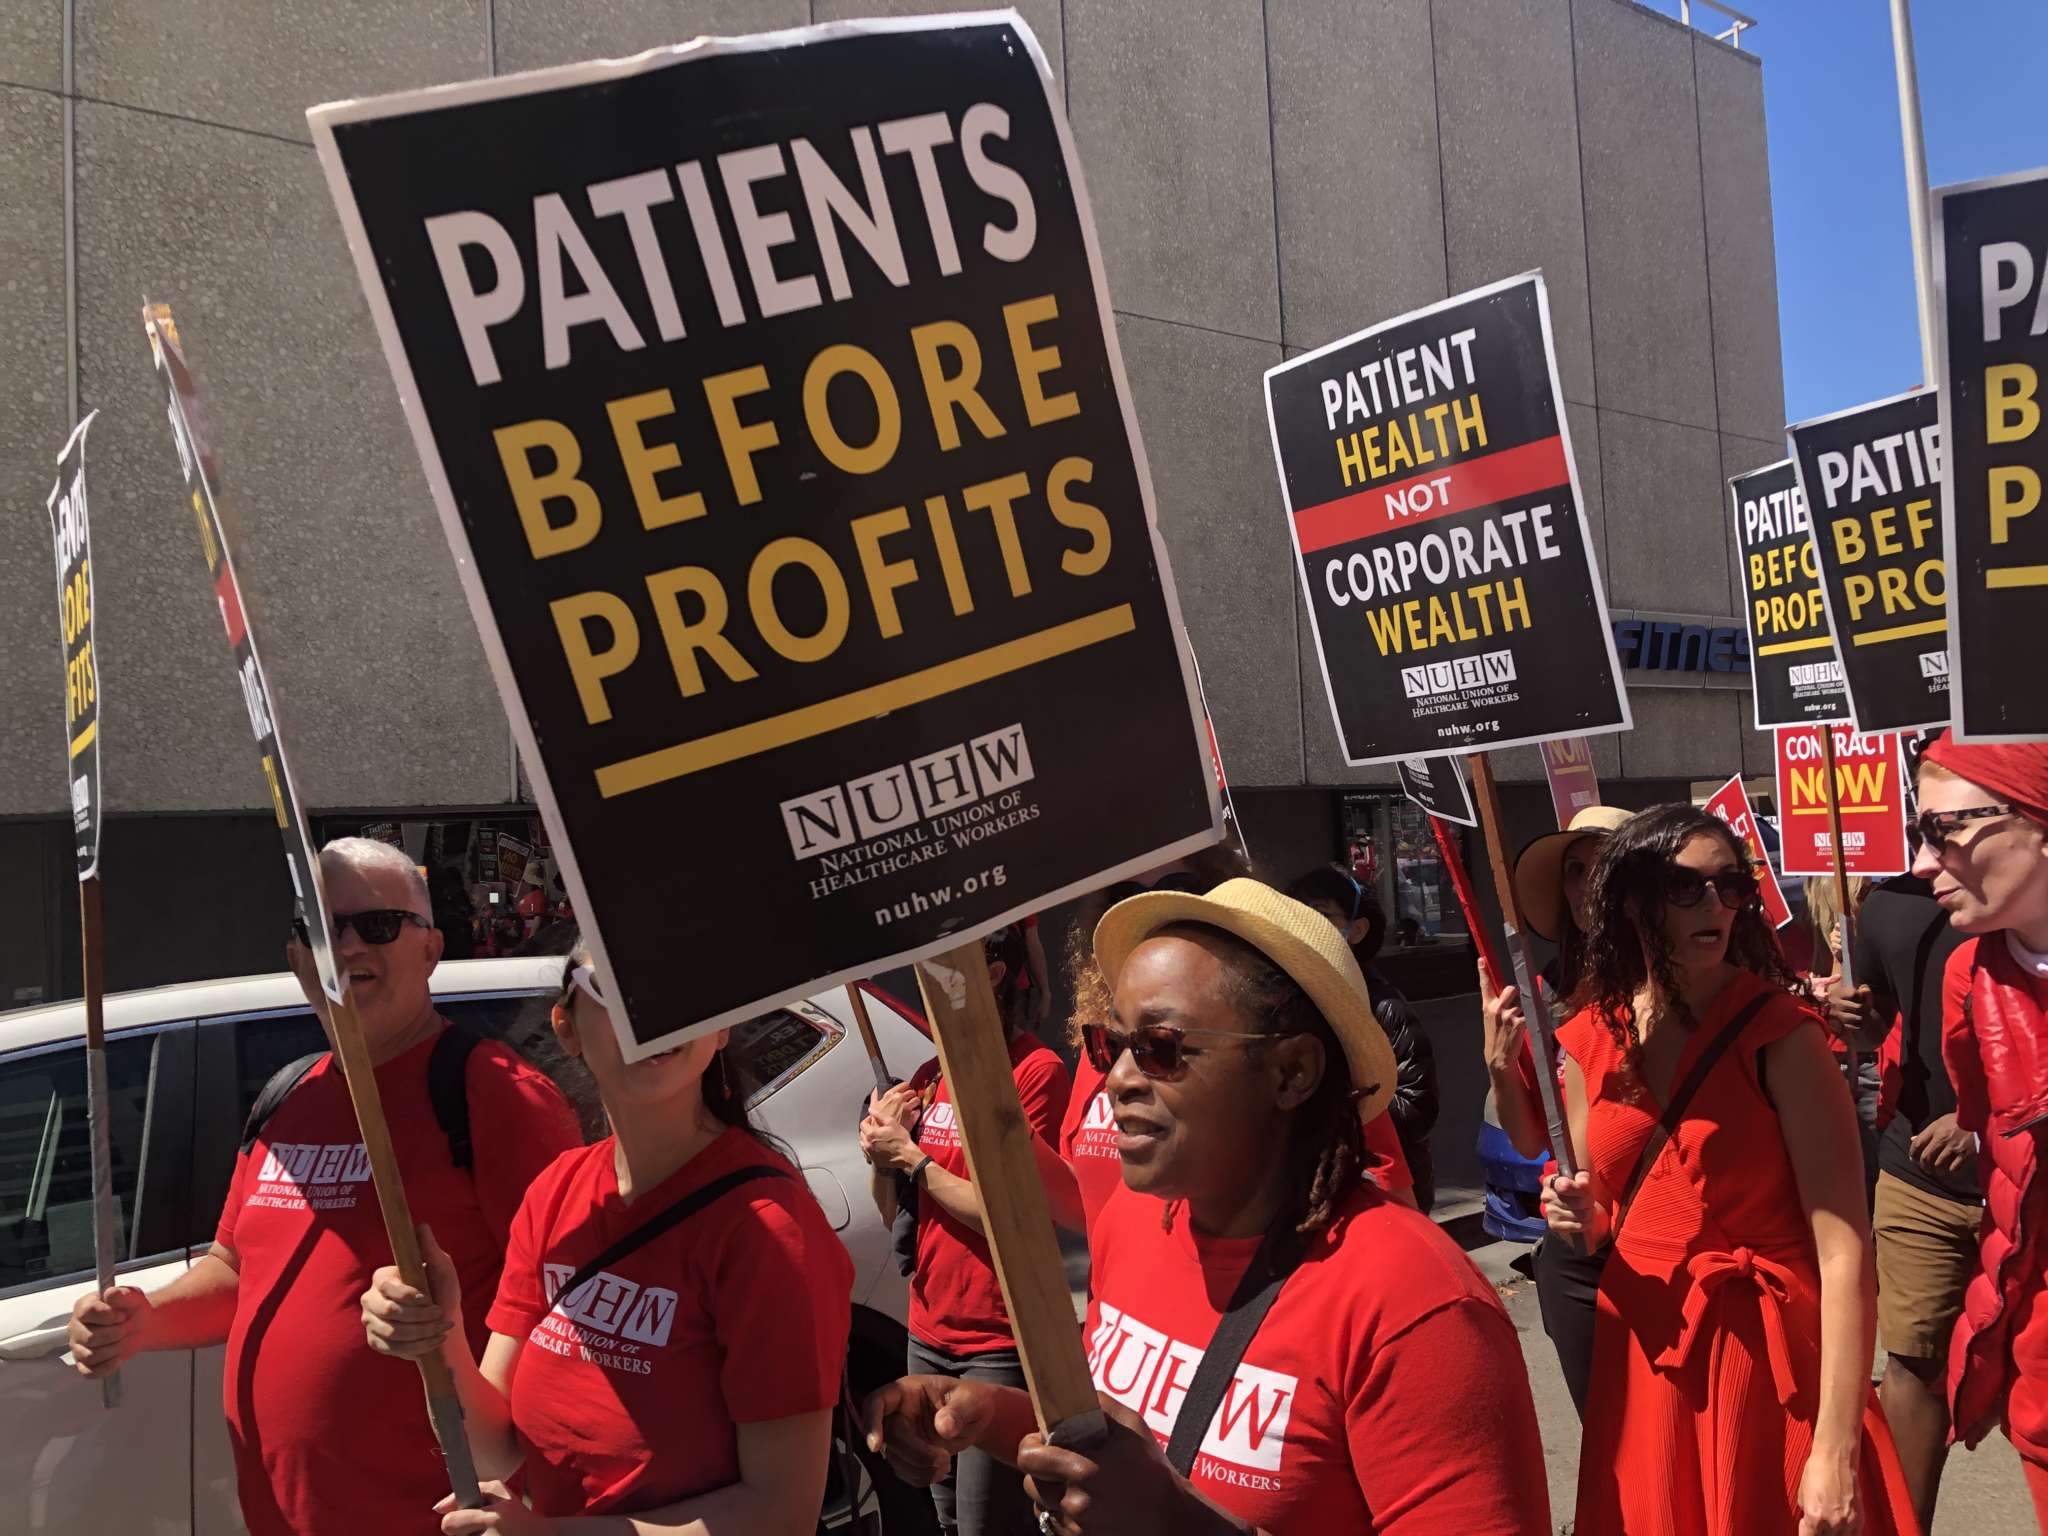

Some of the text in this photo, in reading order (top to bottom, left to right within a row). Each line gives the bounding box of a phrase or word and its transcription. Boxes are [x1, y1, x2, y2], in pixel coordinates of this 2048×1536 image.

[425, 103, 1037, 386] PATIENTS
[1321, 328, 1477, 431] PATIENT
[492, 294, 1081, 561] BEFORE
[1336, 393, 1489, 488] HEALTH
[1384, 476, 1452, 522] NOT
[1324, 504, 1562, 608] CORPORATE
[550, 456, 1113, 726] PROFITS
[1366, 577, 1533, 657] WEALTH
[1401, 649, 1517, 698] NUHW
[1416, 684, 1510, 708] NATIONAL UNION OF
[1412, 693, 1520, 719] HEALTHCARE WORKERS
[1437, 720, 1500, 737] nuhw.org
[1785, 732, 1885, 761] CONRACT
[780, 722, 1035, 861] NUHW
[809, 803, 1041, 900] HEALTHCARE WORKERS
[819, 789, 1023, 876] NATIONAL UNION OF
[874, 863, 1007, 926] nuhw.org
[306, 1185, 338, 1198] UNION
[339, 1185, 355, 1195] OF
[568, 1324, 618, 1350] UNION
[579, 1345, 651, 1375] WORKERS
[1200, 1457, 1281, 1491] WORKERS
